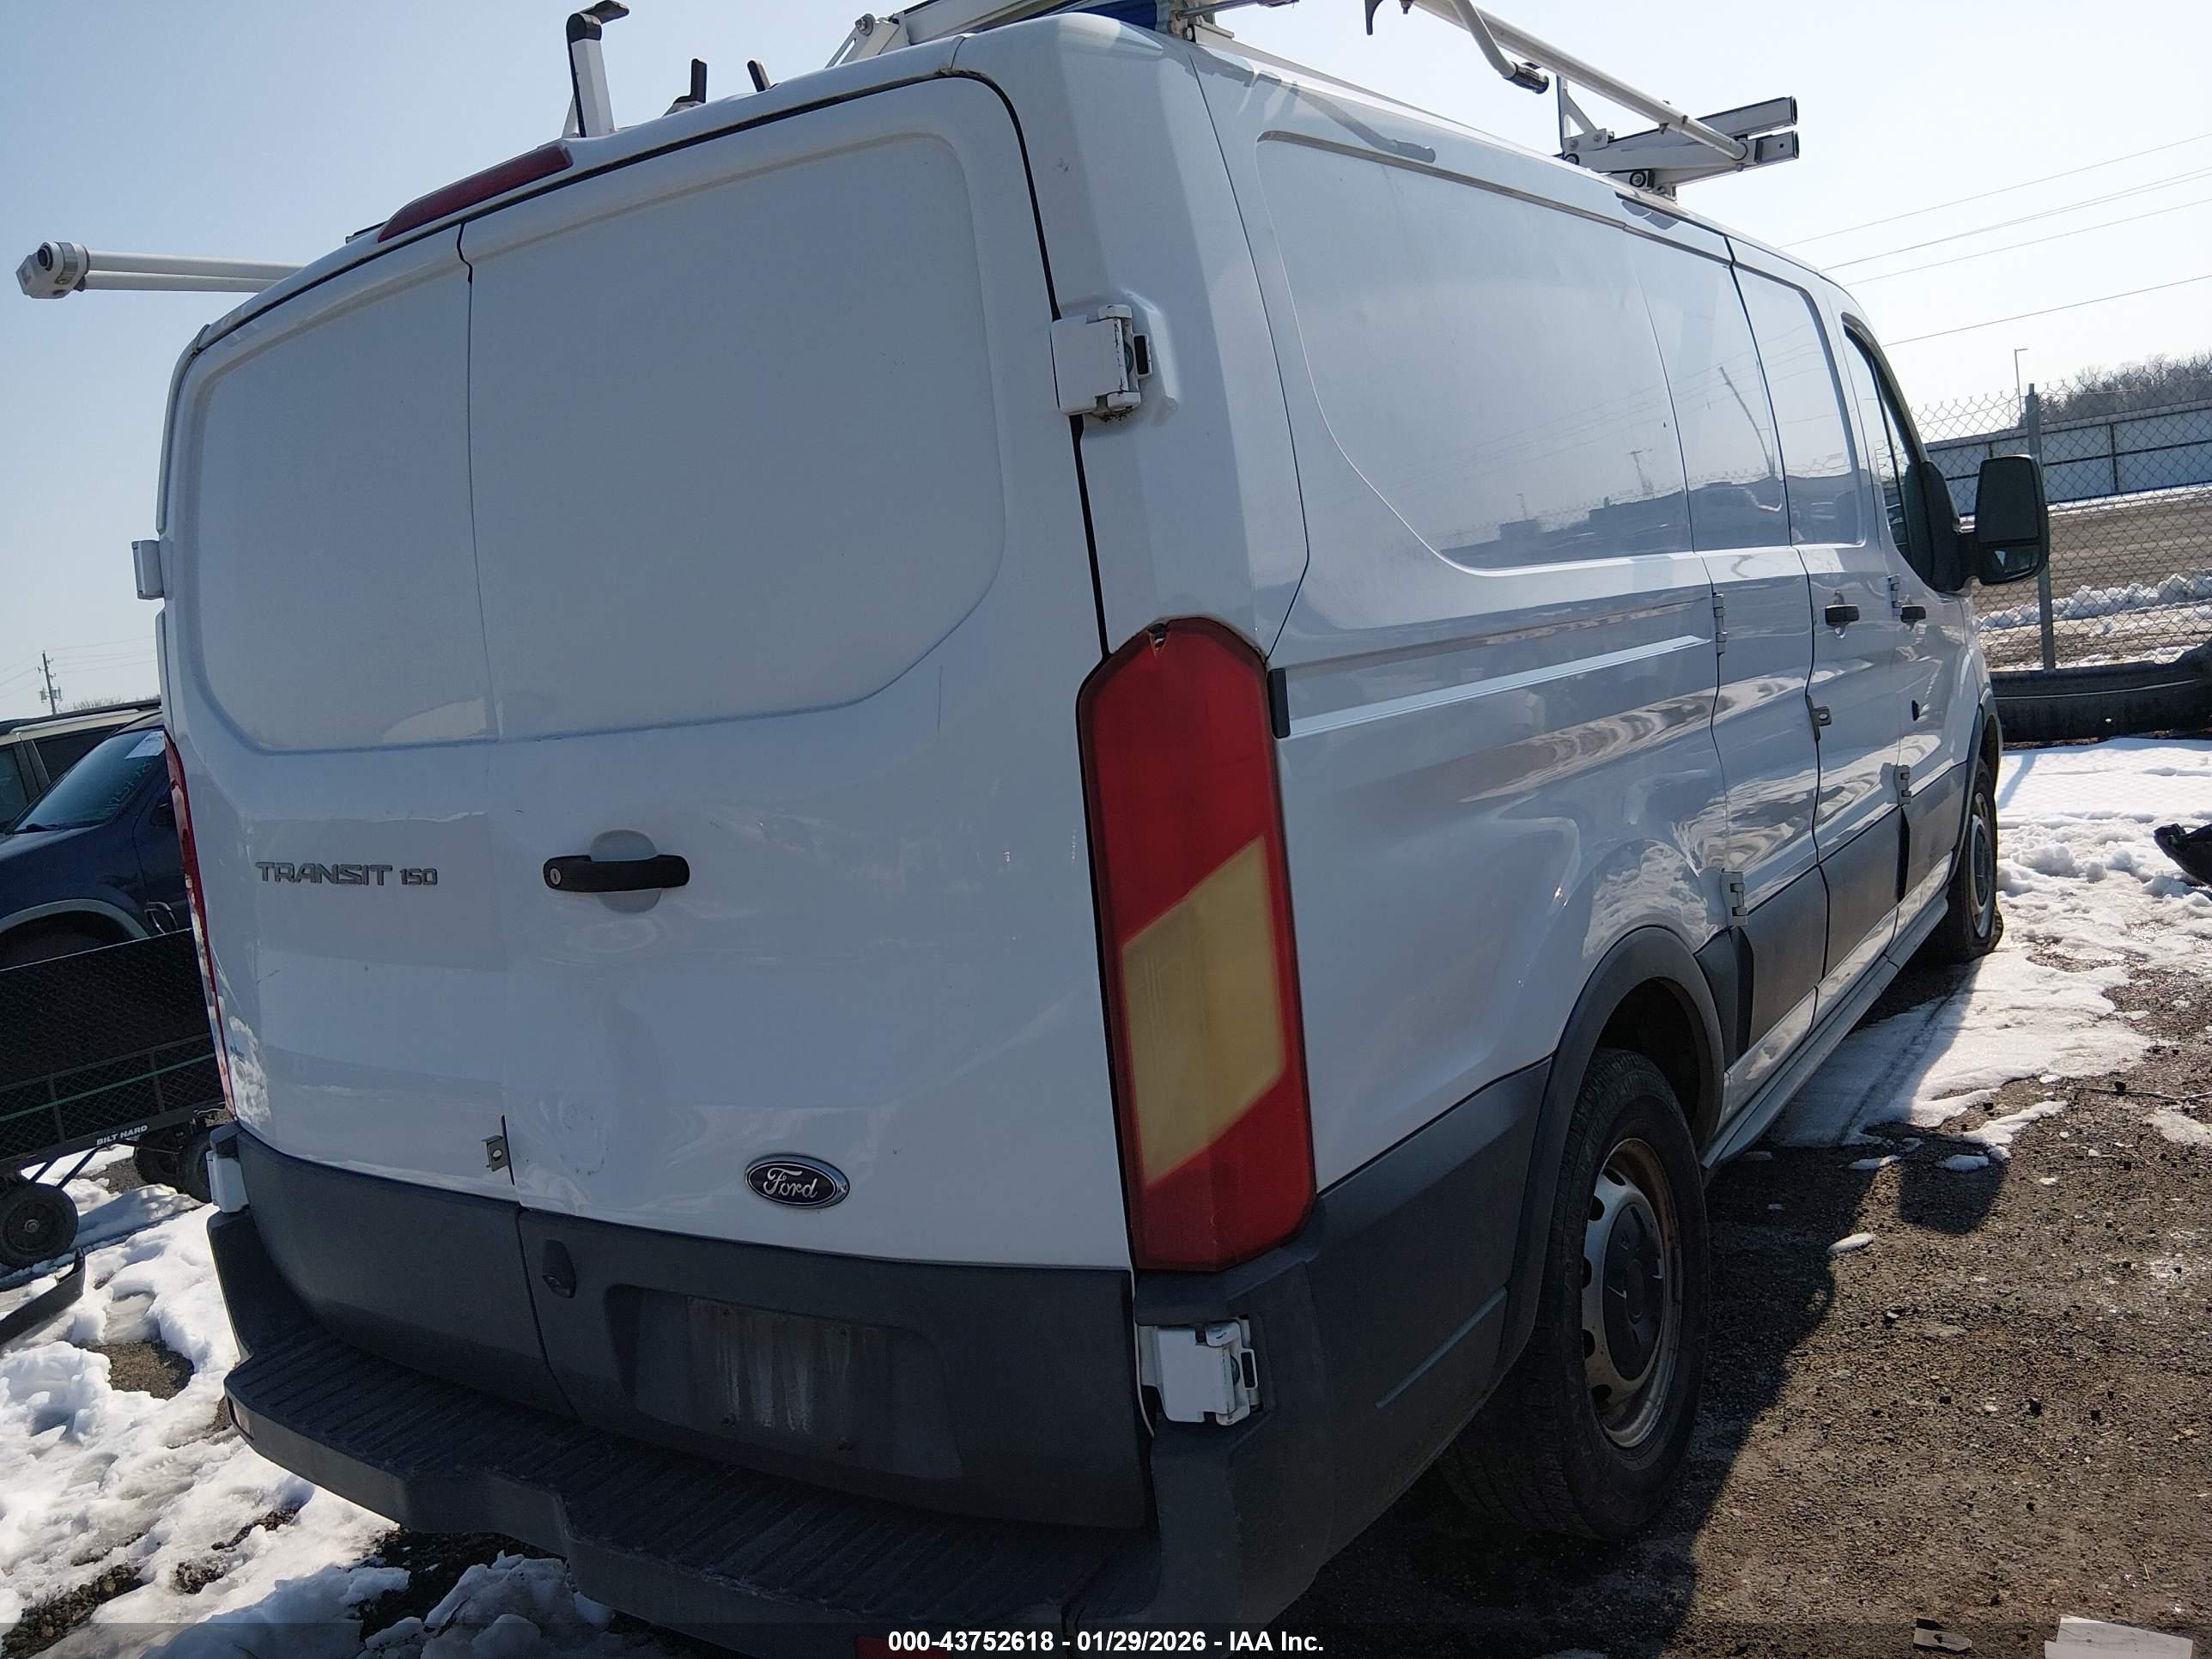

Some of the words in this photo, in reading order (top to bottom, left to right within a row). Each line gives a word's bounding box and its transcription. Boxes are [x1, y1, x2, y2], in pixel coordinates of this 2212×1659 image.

[255, 861, 392, 885] TRANSIT
[399, 868, 438, 885] 150
[96, 1133, 118, 1146] BILT
[120, 1125, 148, 1139] HARD
[763, 1167, 818, 1199] Ford
